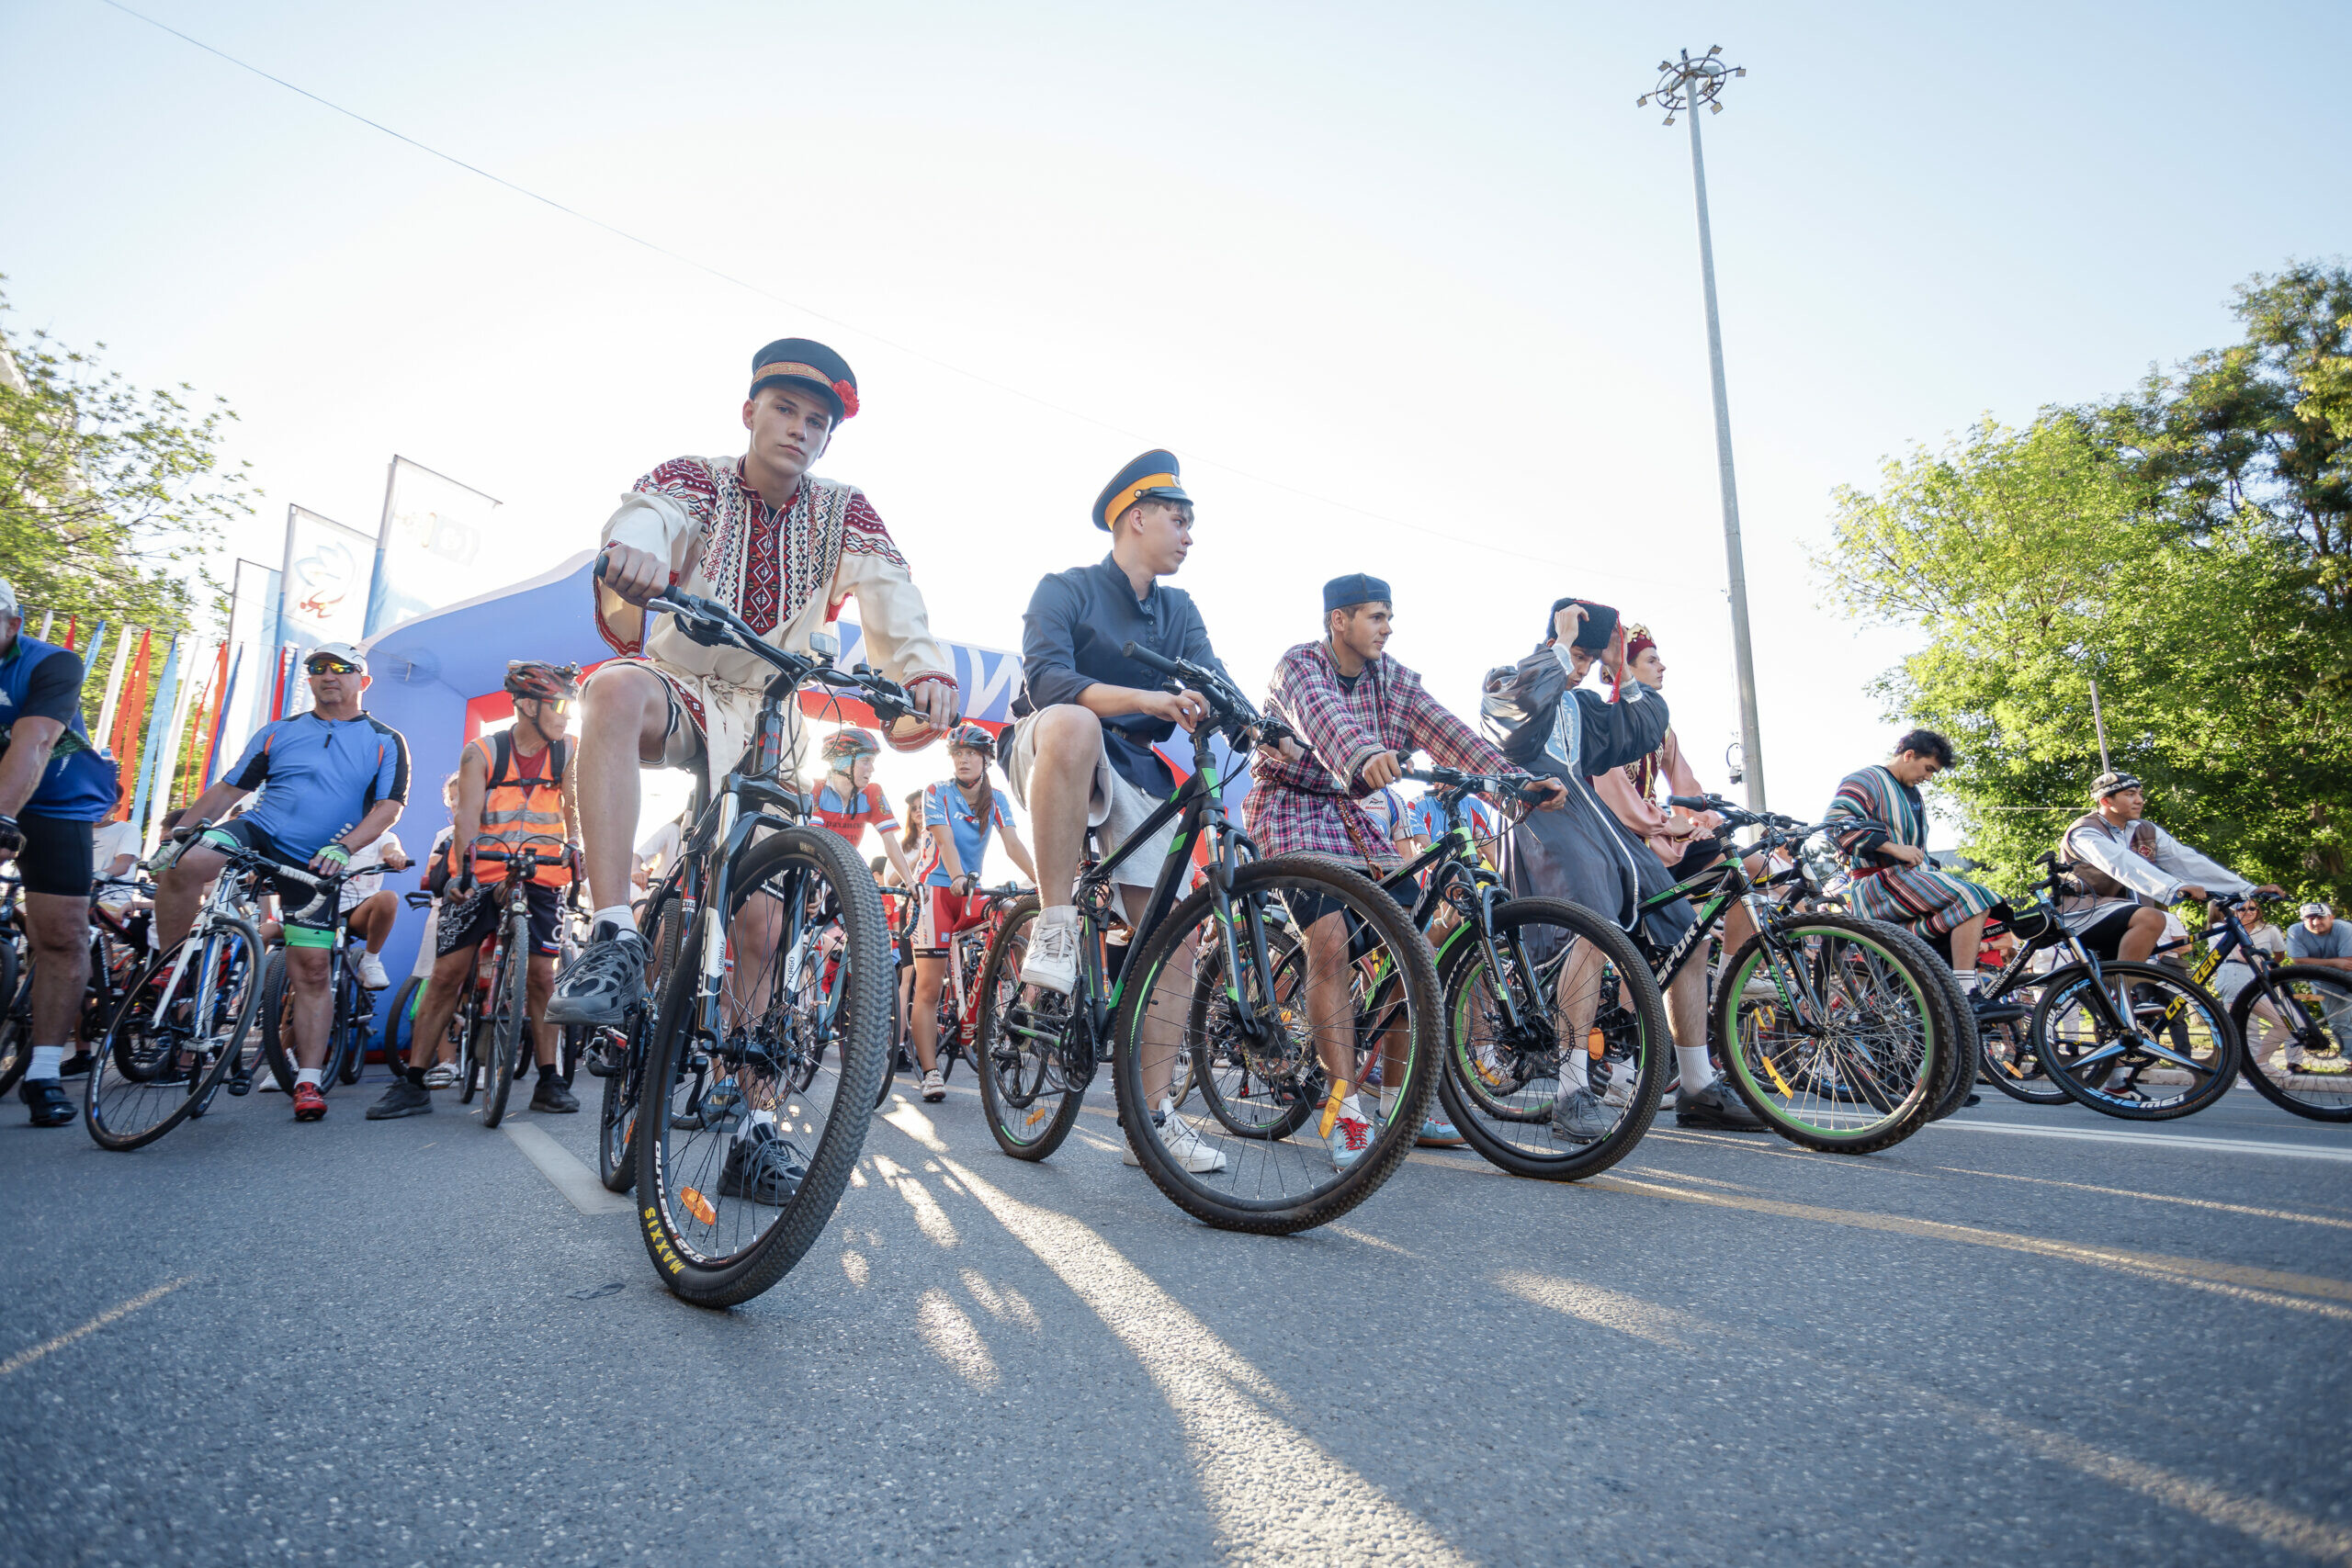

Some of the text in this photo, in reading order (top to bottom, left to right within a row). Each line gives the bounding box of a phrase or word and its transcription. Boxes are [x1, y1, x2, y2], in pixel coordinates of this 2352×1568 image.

[962, 949, 992, 1022] FOCUS
[1656, 913, 1705, 987] SPORT
[645, 1206, 687, 1275] MAXXIS
